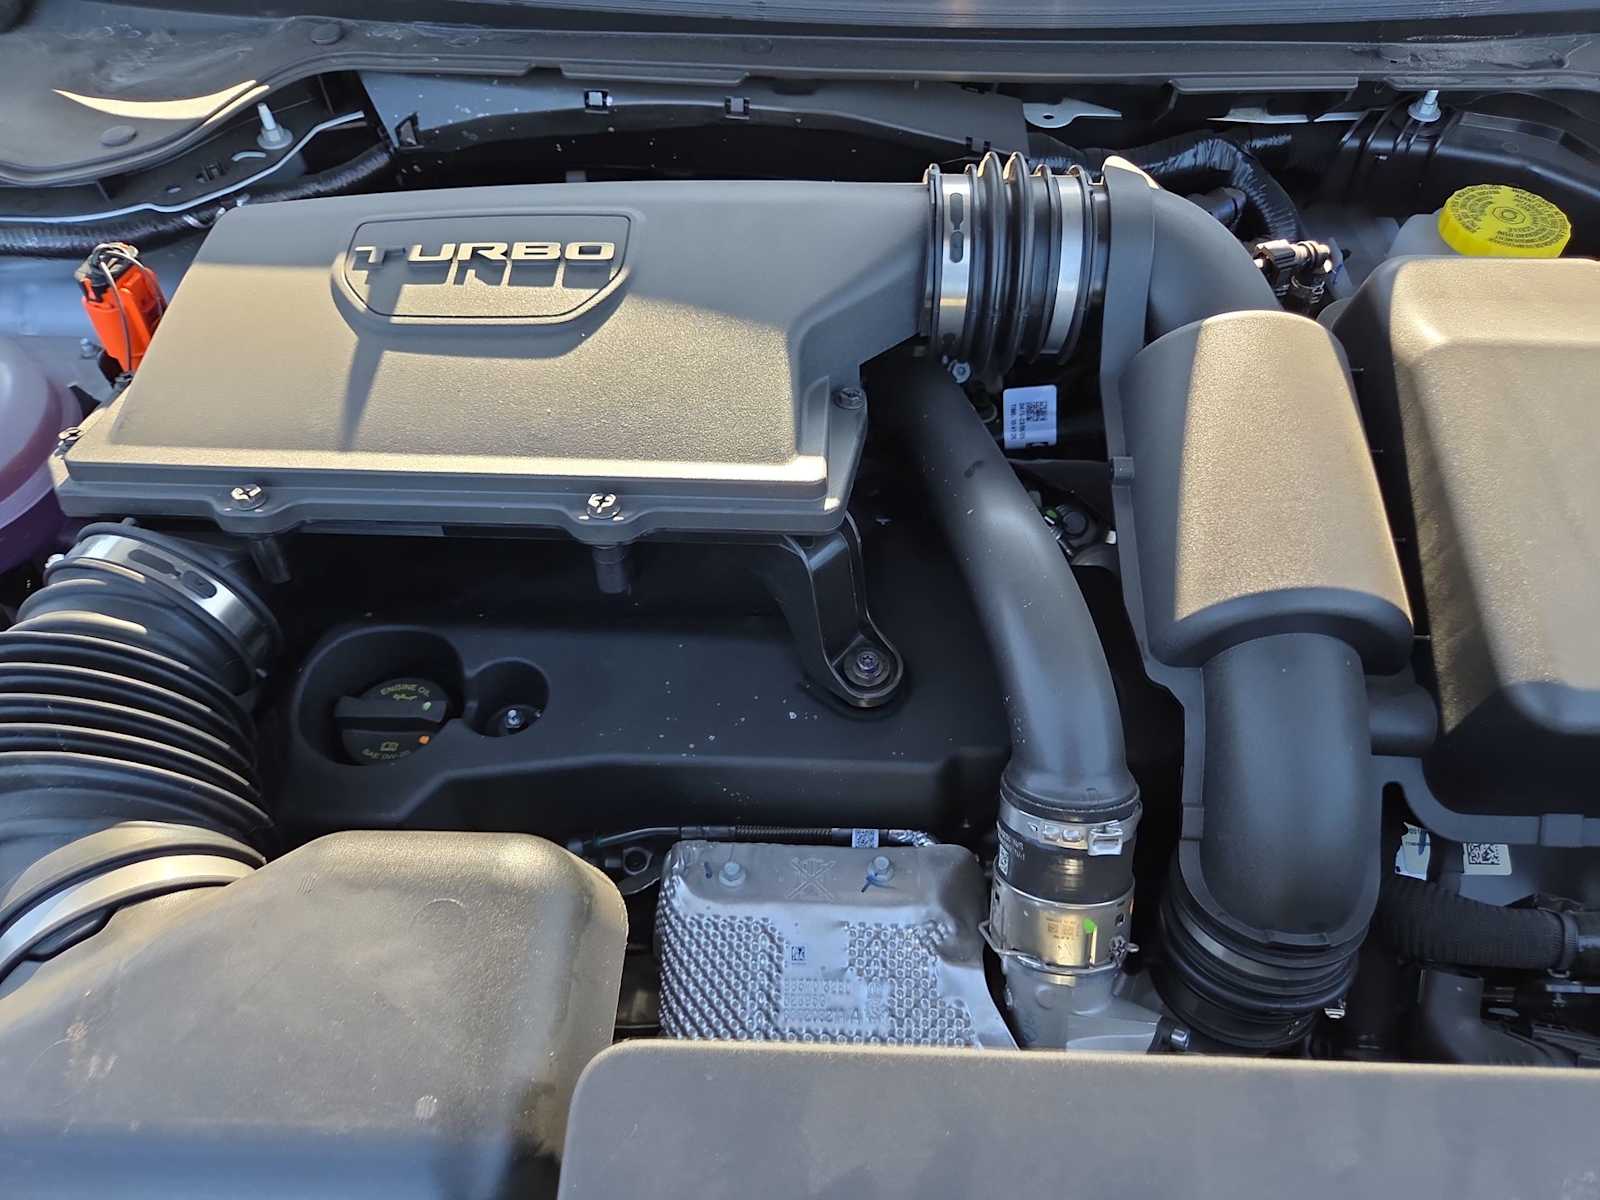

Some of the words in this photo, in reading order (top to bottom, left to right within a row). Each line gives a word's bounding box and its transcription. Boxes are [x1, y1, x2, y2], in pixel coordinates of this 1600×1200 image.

[355, 241, 615, 264] TURBO
[380, 683, 418, 696] ENGINE
[418, 686, 431, 698] OIL
